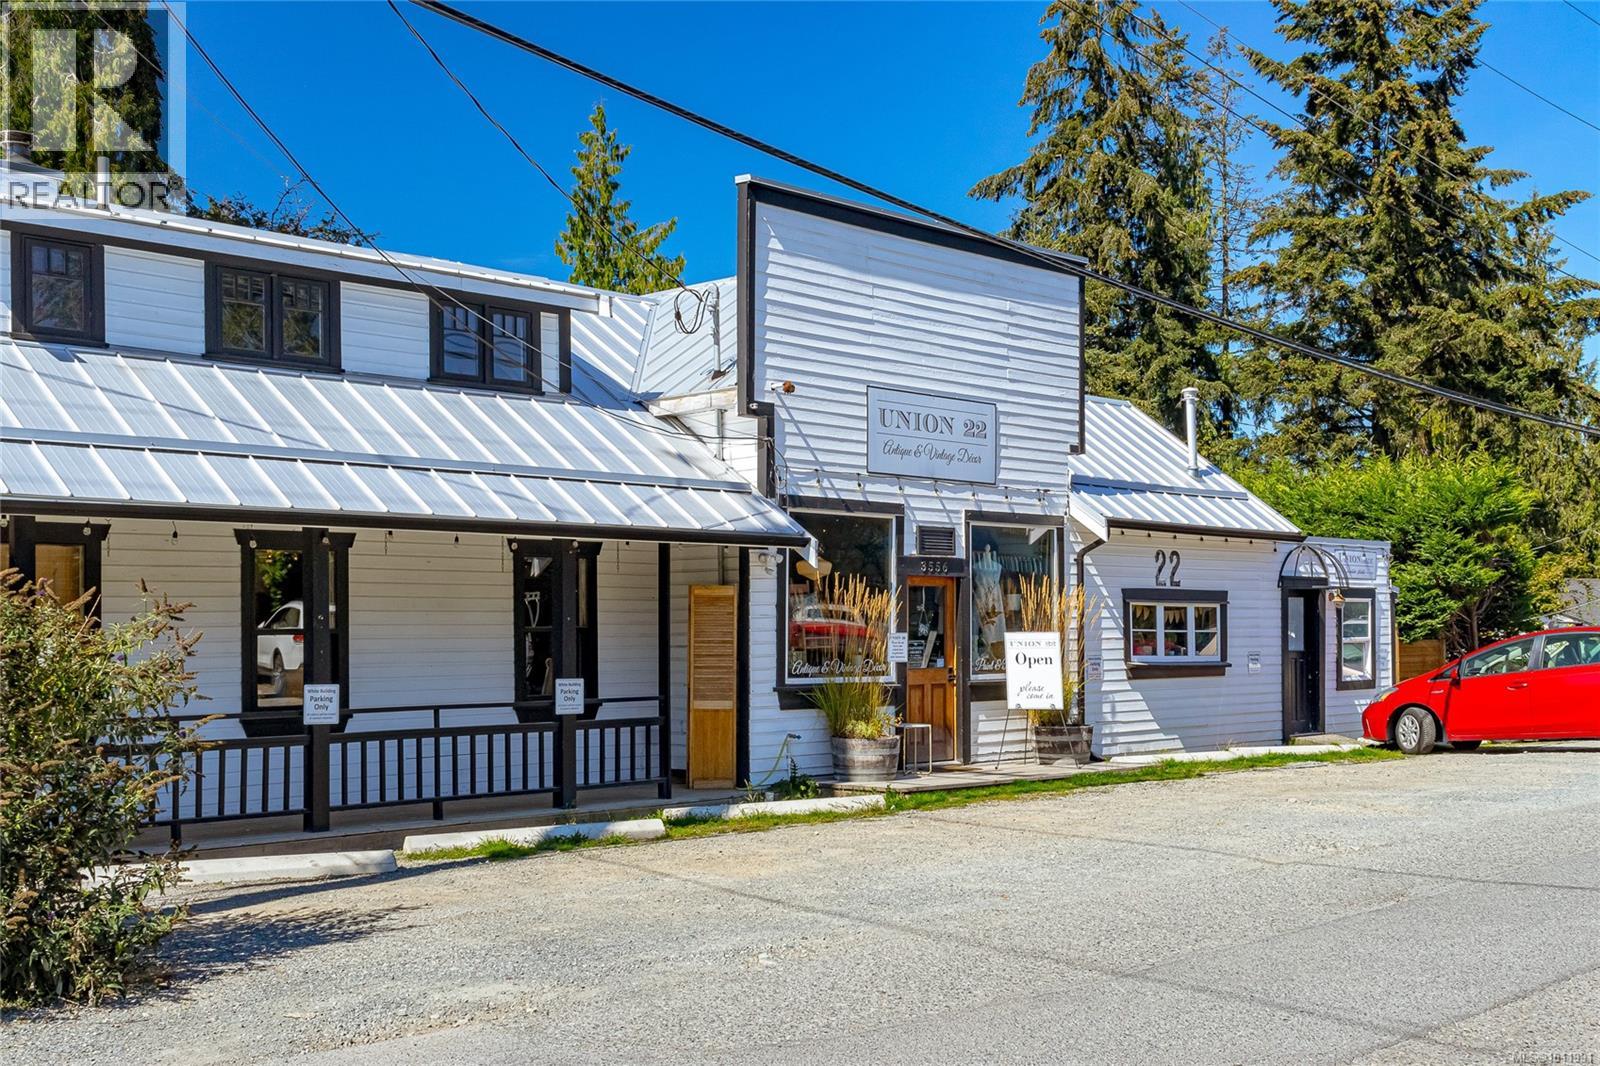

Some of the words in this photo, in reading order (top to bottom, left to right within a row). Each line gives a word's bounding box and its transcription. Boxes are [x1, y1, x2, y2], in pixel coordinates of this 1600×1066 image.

[879, 407, 955, 436] UNION
[963, 419, 987, 439] 22
[882, 439, 912, 460] Antique
[913, 444, 922, 458] &
[923, 443, 955, 466] Vintage
[920, 560, 948, 573] 3556
[1155, 549, 1181, 587] 22
[1010, 640, 1041, 648] UNION
[792, 659, 820, 678] Antique
[821, 660, 831, 674] &
[1015, 651, 1053, 669] Open
[1017, 681, 1044, 697] please
[1027, 692, 1043, 700] come
